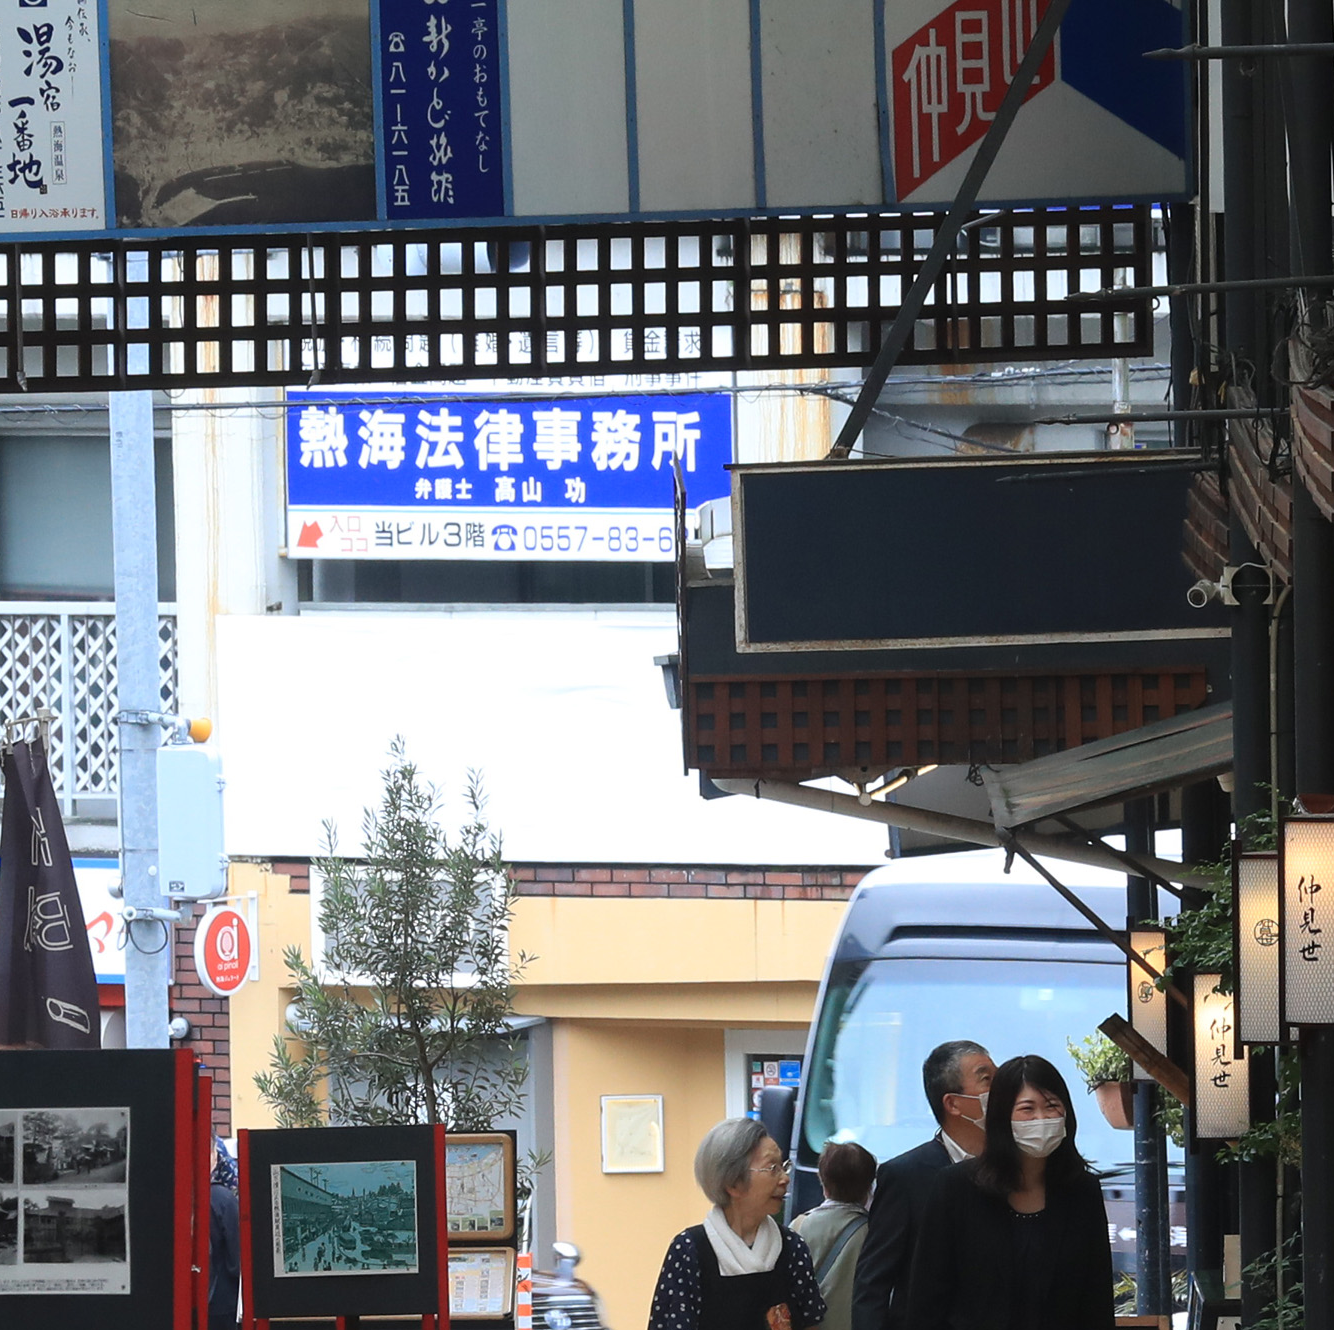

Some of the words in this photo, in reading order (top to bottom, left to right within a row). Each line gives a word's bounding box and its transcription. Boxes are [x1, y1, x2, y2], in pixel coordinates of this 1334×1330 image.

[53, 125, 65, 182] 熱海温泉
[298, 406, 702, 473] 熱海法律事務所
[414, 477, 472, 501] 弁護士
[565, 478, 587, 504] 功
[374, 521, 486, 549] 当ビル3階
[523, 524, 675, 553] 0557-83-6
[1298, 875, 1322, 962] 仲見世
[1210, 1017, 1232, 1089] 仲見世
